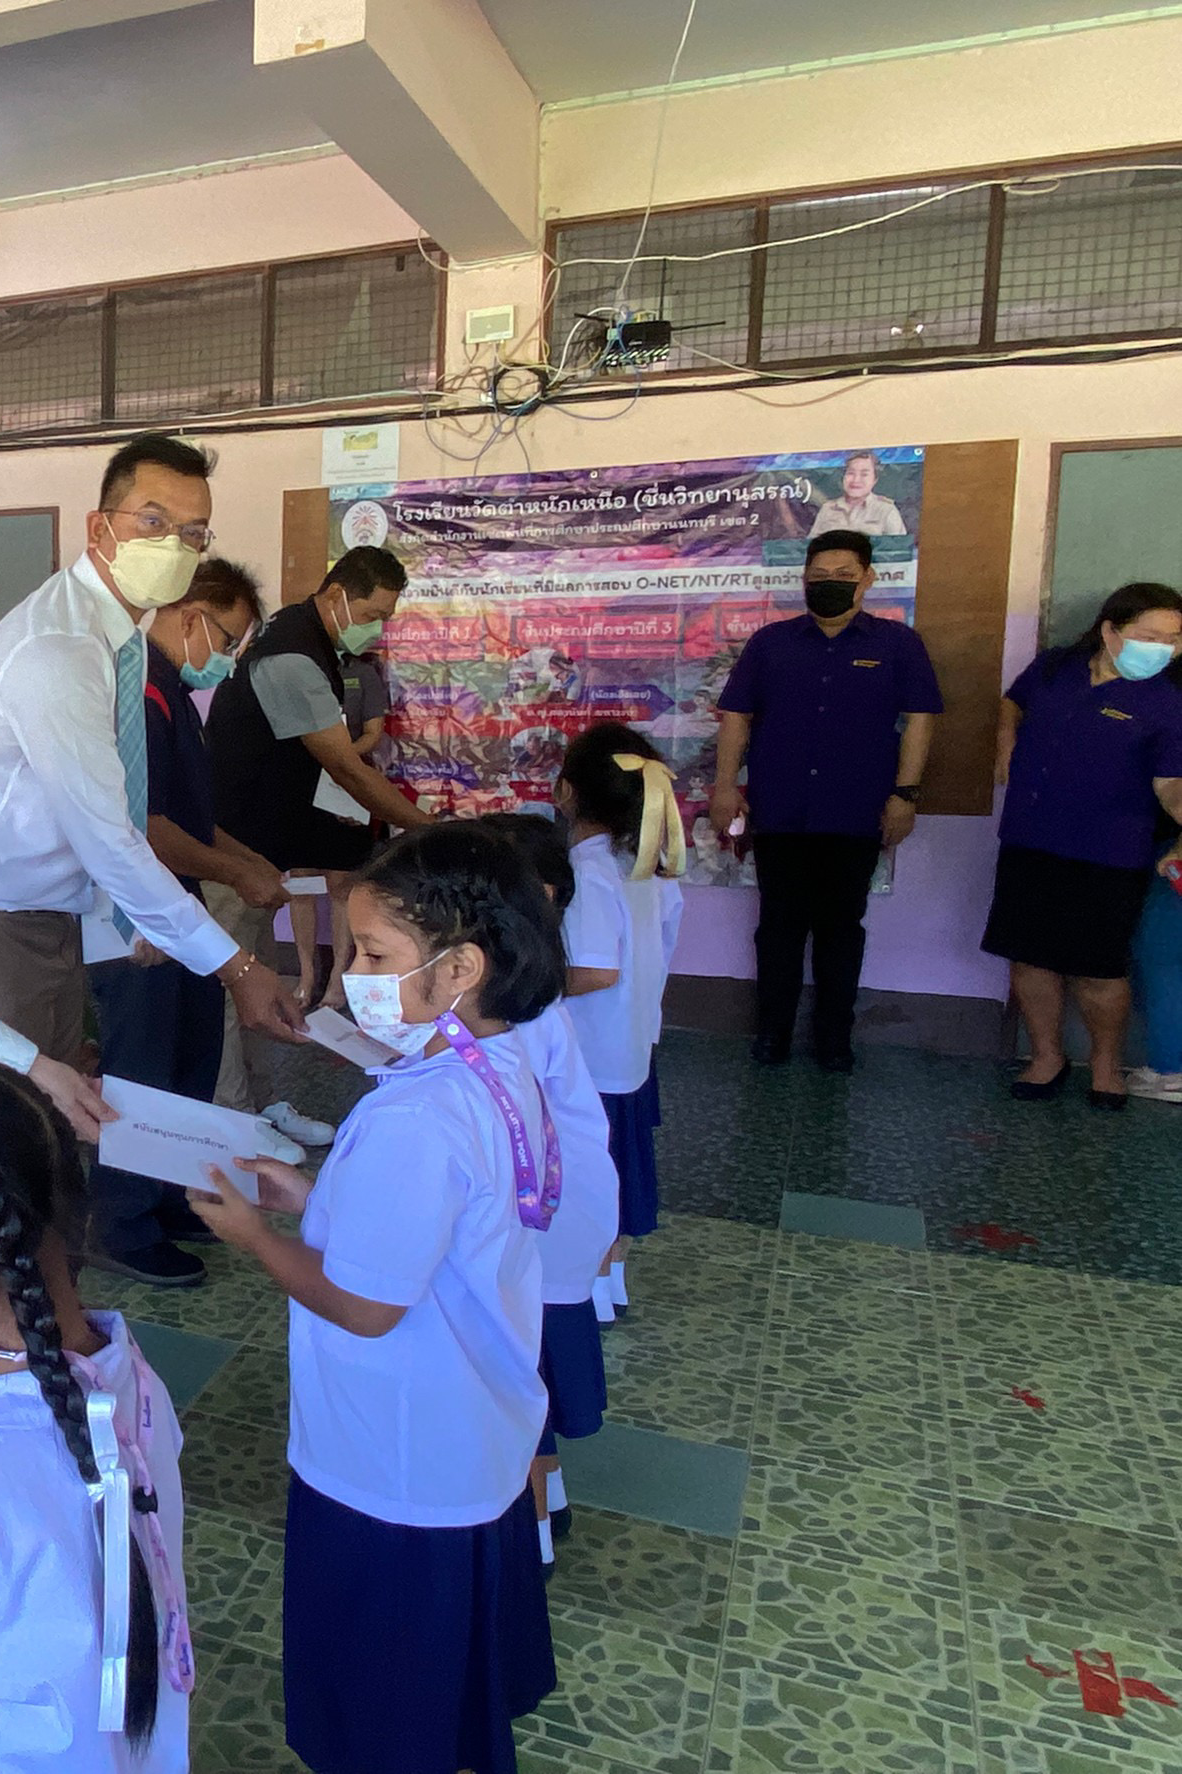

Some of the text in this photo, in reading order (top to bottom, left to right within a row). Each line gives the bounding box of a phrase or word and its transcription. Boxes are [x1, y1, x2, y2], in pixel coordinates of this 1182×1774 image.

[392, 477, 813, 522] โรงเรียนวัดตำหนักเหนือ (ชื่นวิทยานุสรณ์)
[750, 514, 760, 526] 2
[636, 573, 752, 591] O-NET/NT/RT
[752, 571, 803, 591] สูงกว่า
[661, 621, 673, 635] 3
[517, 1141, 529, 1168] PONY
